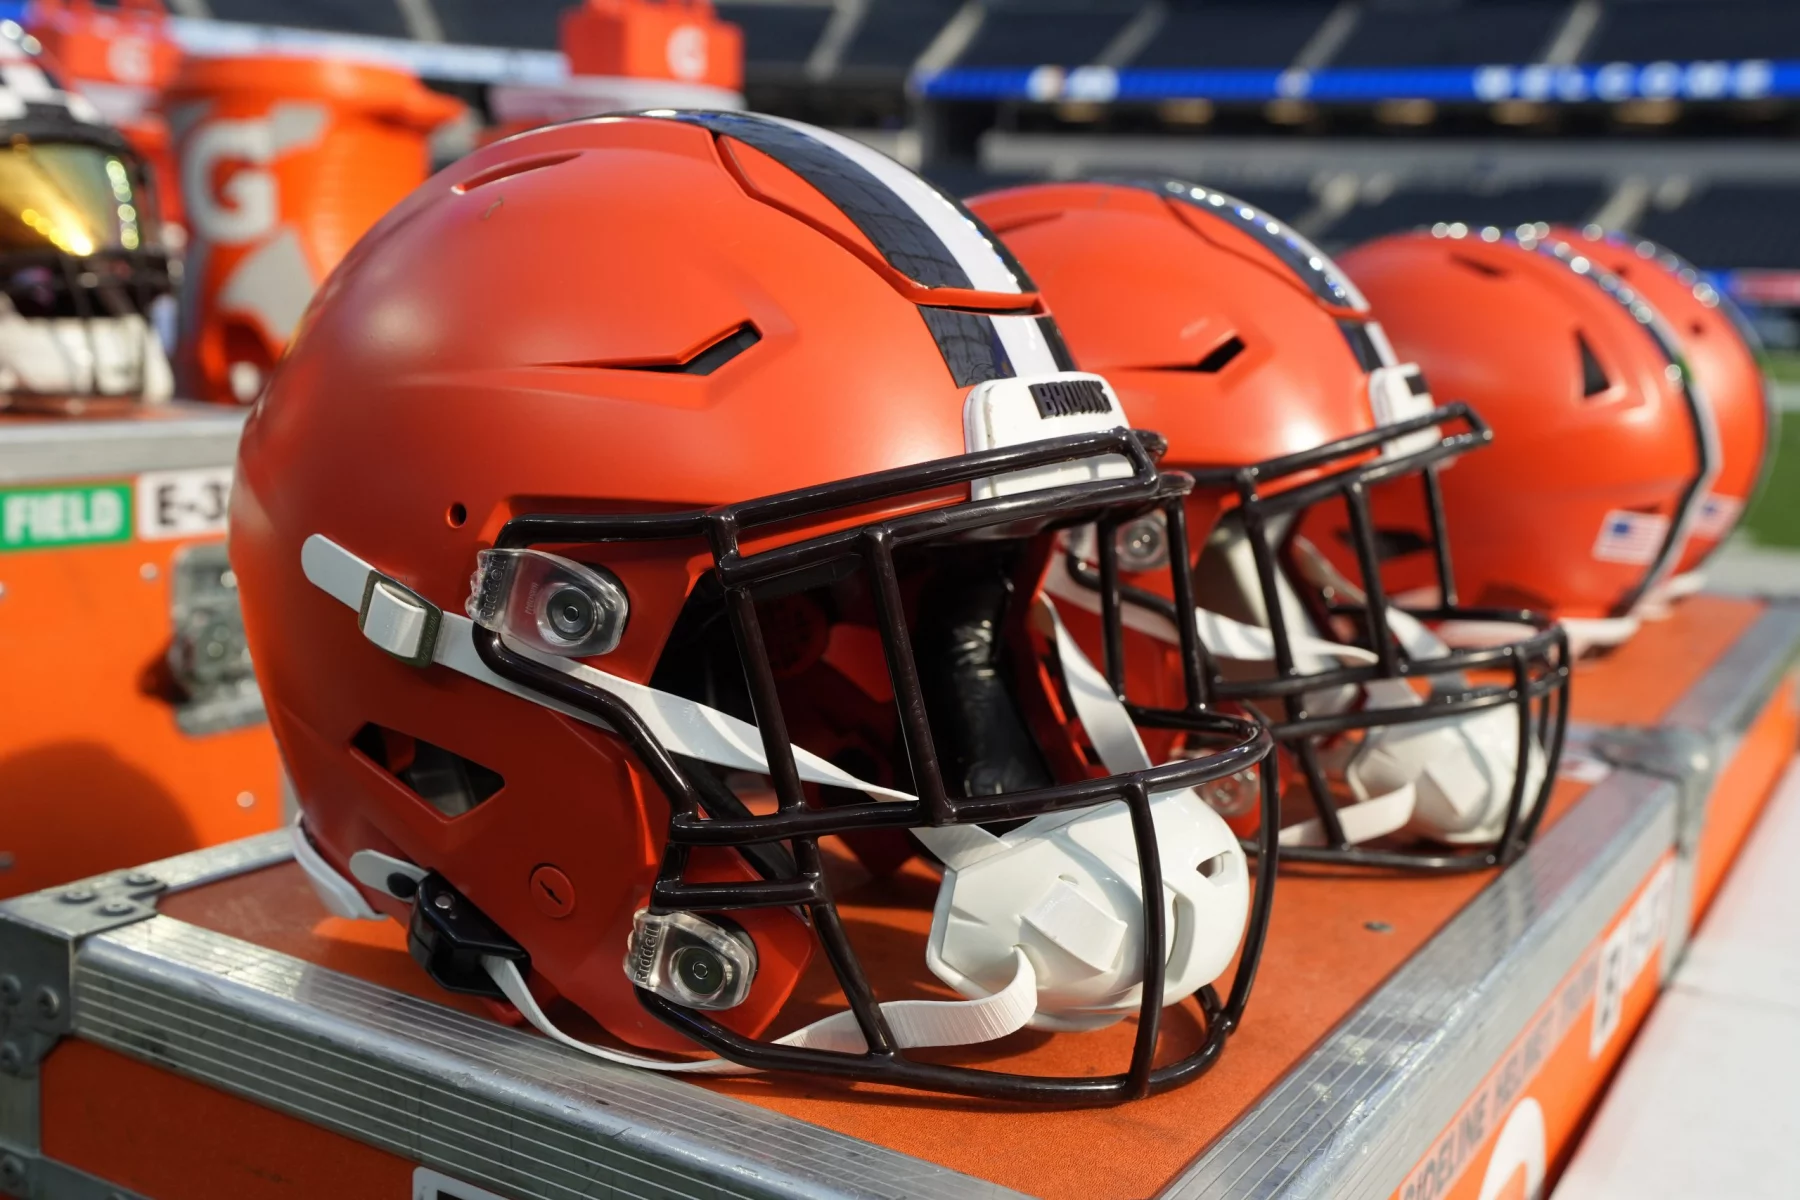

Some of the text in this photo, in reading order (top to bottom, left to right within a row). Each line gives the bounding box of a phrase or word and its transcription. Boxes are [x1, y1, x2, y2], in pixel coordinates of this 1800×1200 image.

[183, 119, 275, 245] G
[4, 488, 124, 545] FIELD
[632, 924, 660, 985] Riddell
